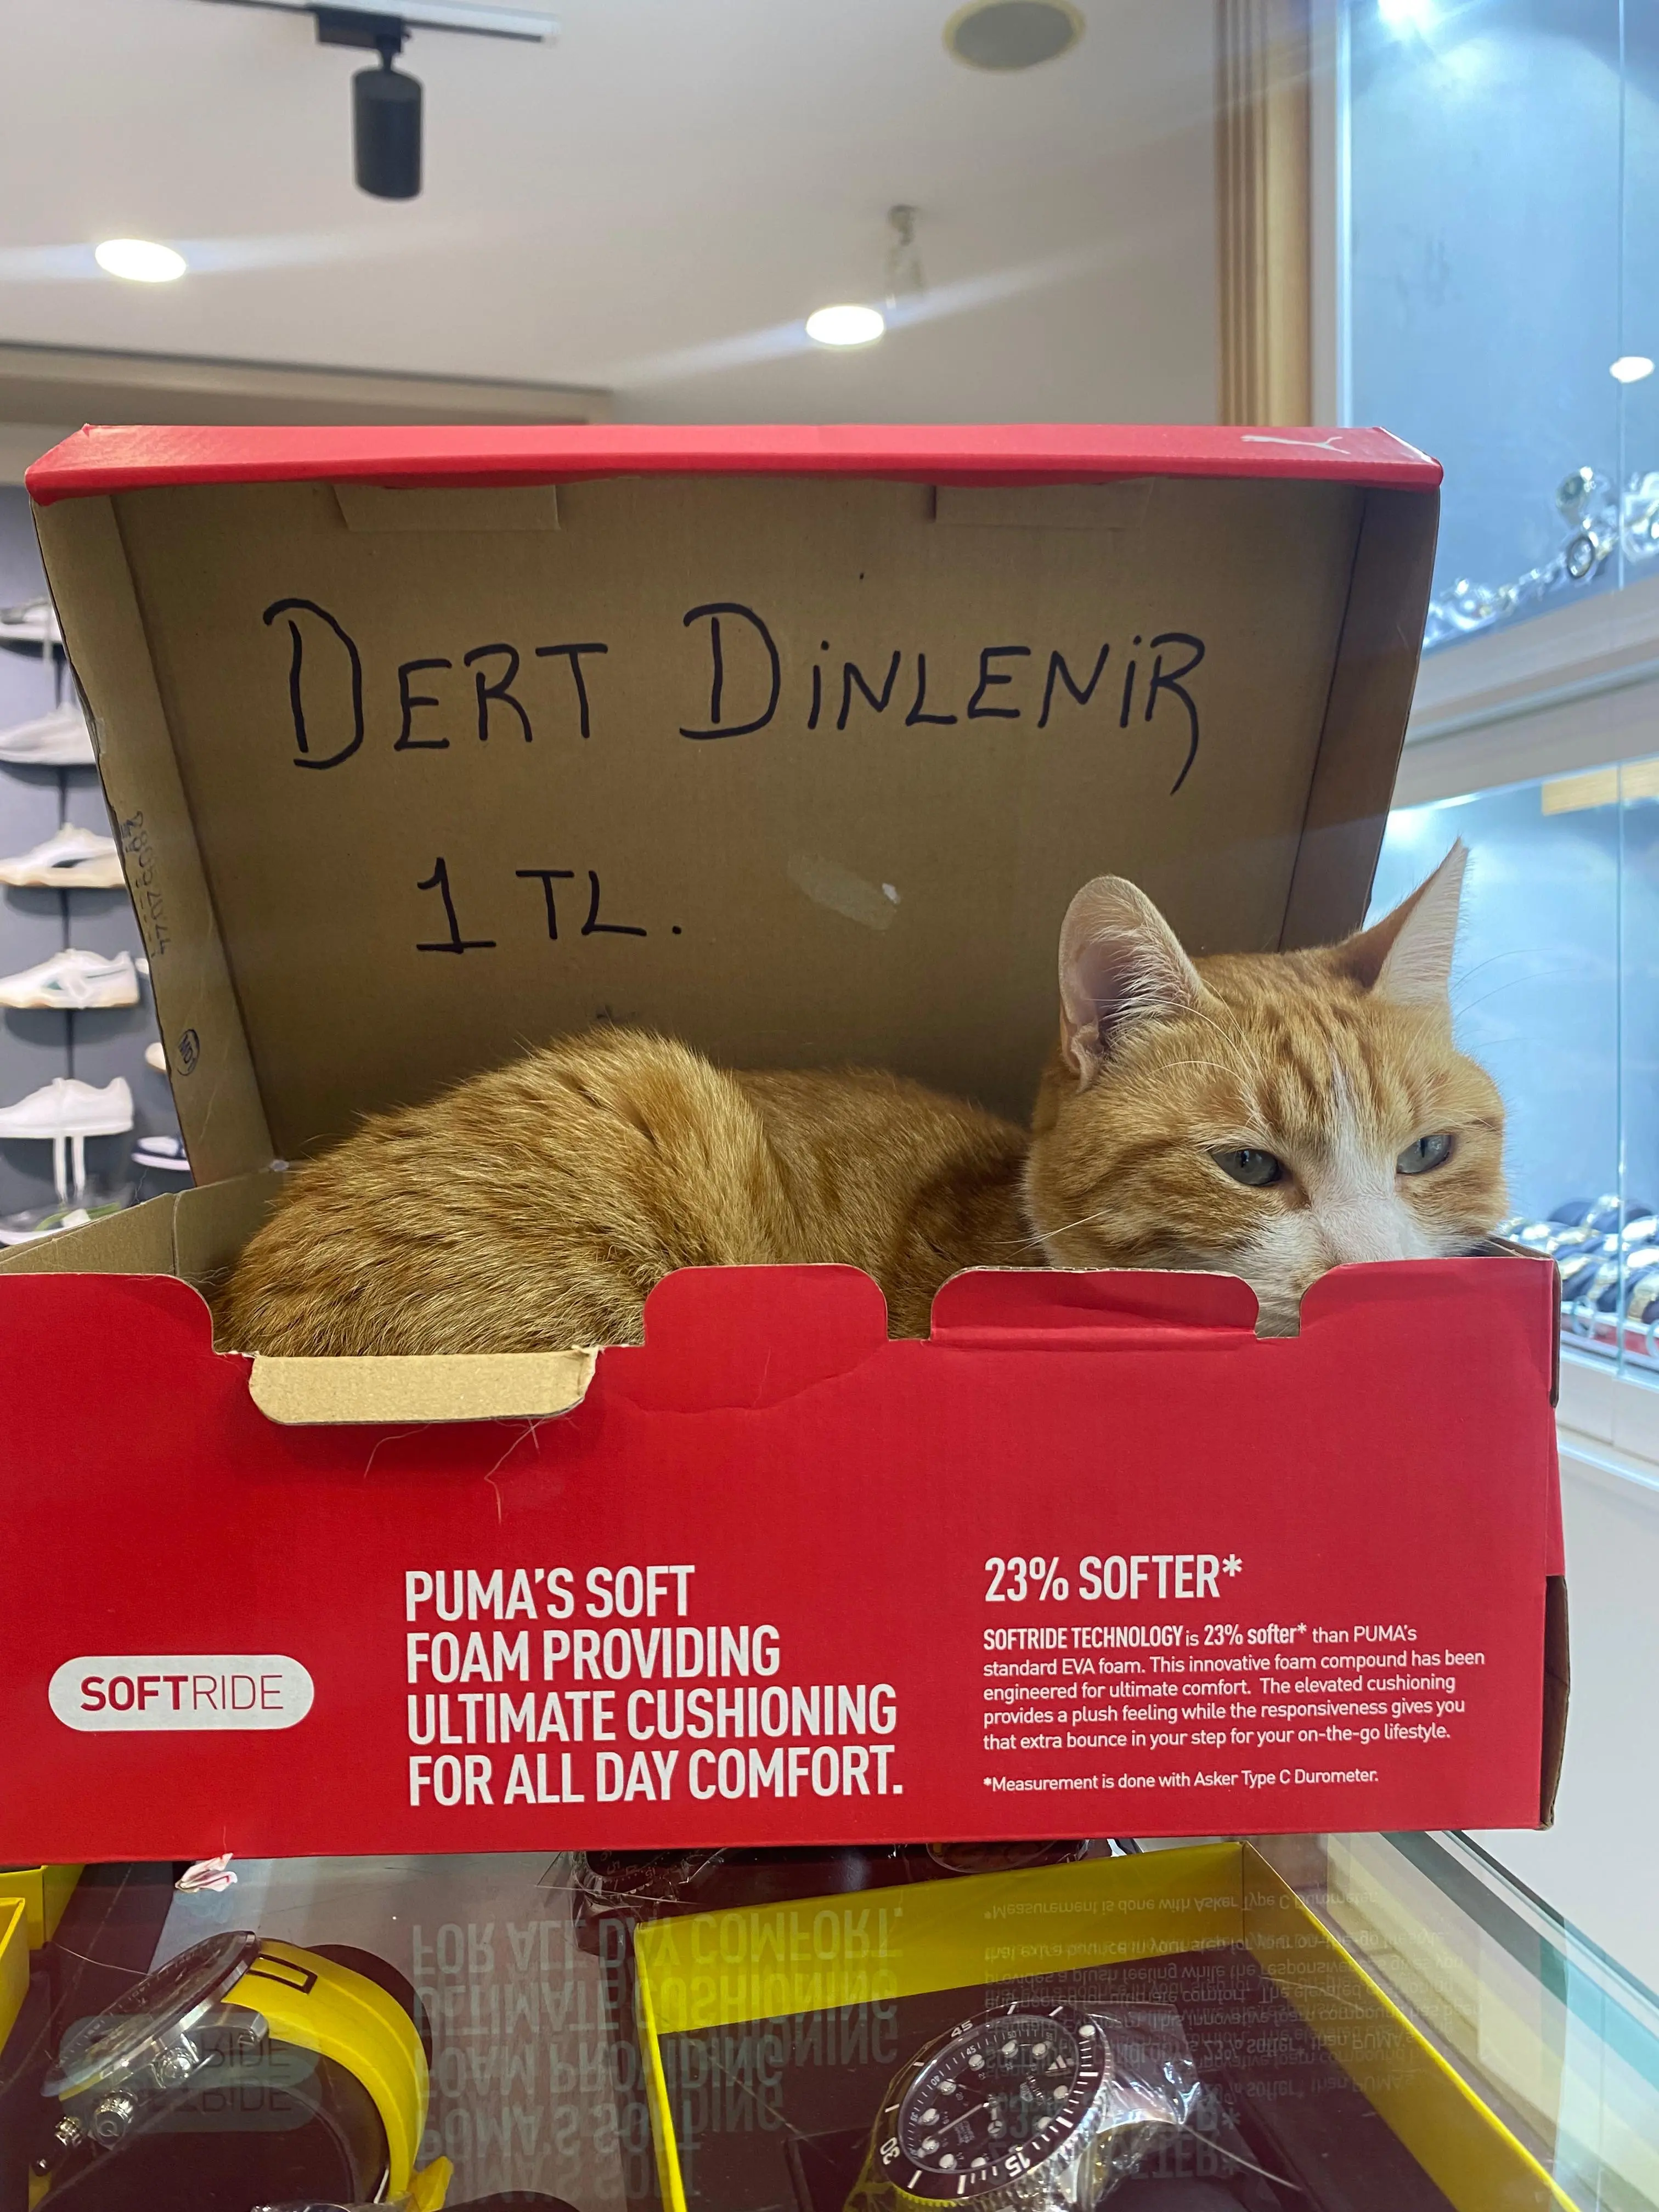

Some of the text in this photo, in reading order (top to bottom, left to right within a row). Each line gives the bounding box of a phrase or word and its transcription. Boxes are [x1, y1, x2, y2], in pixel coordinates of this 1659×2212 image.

[263, 599, 607, 770] DERT
[416, 857, 682, 953] 1 TL.
[405, 1565, 695, 1622] PUMA'S SOFT
[985, 1556, 1069, 1602] 23%
[983, 1627, 1068, 1650] SOFTRIDE
[1071, 1625, 1183, 1649] TECHNOLOGY
[1186, 1630, 1199, 1646] is
[1204, 1624, 1243, 1646] 23%
[1312, 1627, 1348, 1643] than
[1353, 1624, 1417, 1642] PUMA's
[407, 1624, 780, 1684] FOAM PROVIDING
[983, 1649, 1485, 1677] standard EVA foam. This innovative foam compound has been
[81, 1675, 283, 1711] SOFTRIDE
[983, 1673, 1455, 1705] engineered for ultimate comfort. The elevated cushioning
[408, 1683, 896, 1745] ULTIMATE CUSHIONING
[984, 1697, 1465, 1729] provides a plush feeling while the responsiveness gives you
[983, 1722, 1451, 1750] that extra bounce in your step for your on-the-go lifestyle.
[409, 1745, 902, 1806] FOR ALL DAY COMFORT.
[1102, 1774, 1114, 1788] is
[1118, 1773, 1155, 1788] done
[1158, 1771, 1190, 1787] with
[1193, 1771, 1239, 1786] Asker
[1241, 1770, 1276, 1789] Type
[1279, 1769, 1291, 1784] C
[1295, 1768, 1379, 1784] Durometer.
[951, 2020, 974, 2038] 45
[966, 2045, 977, 2055] 45
[879, 2137, 900, 2165] 30
[1005, 2152, 1031, 2178] 15
